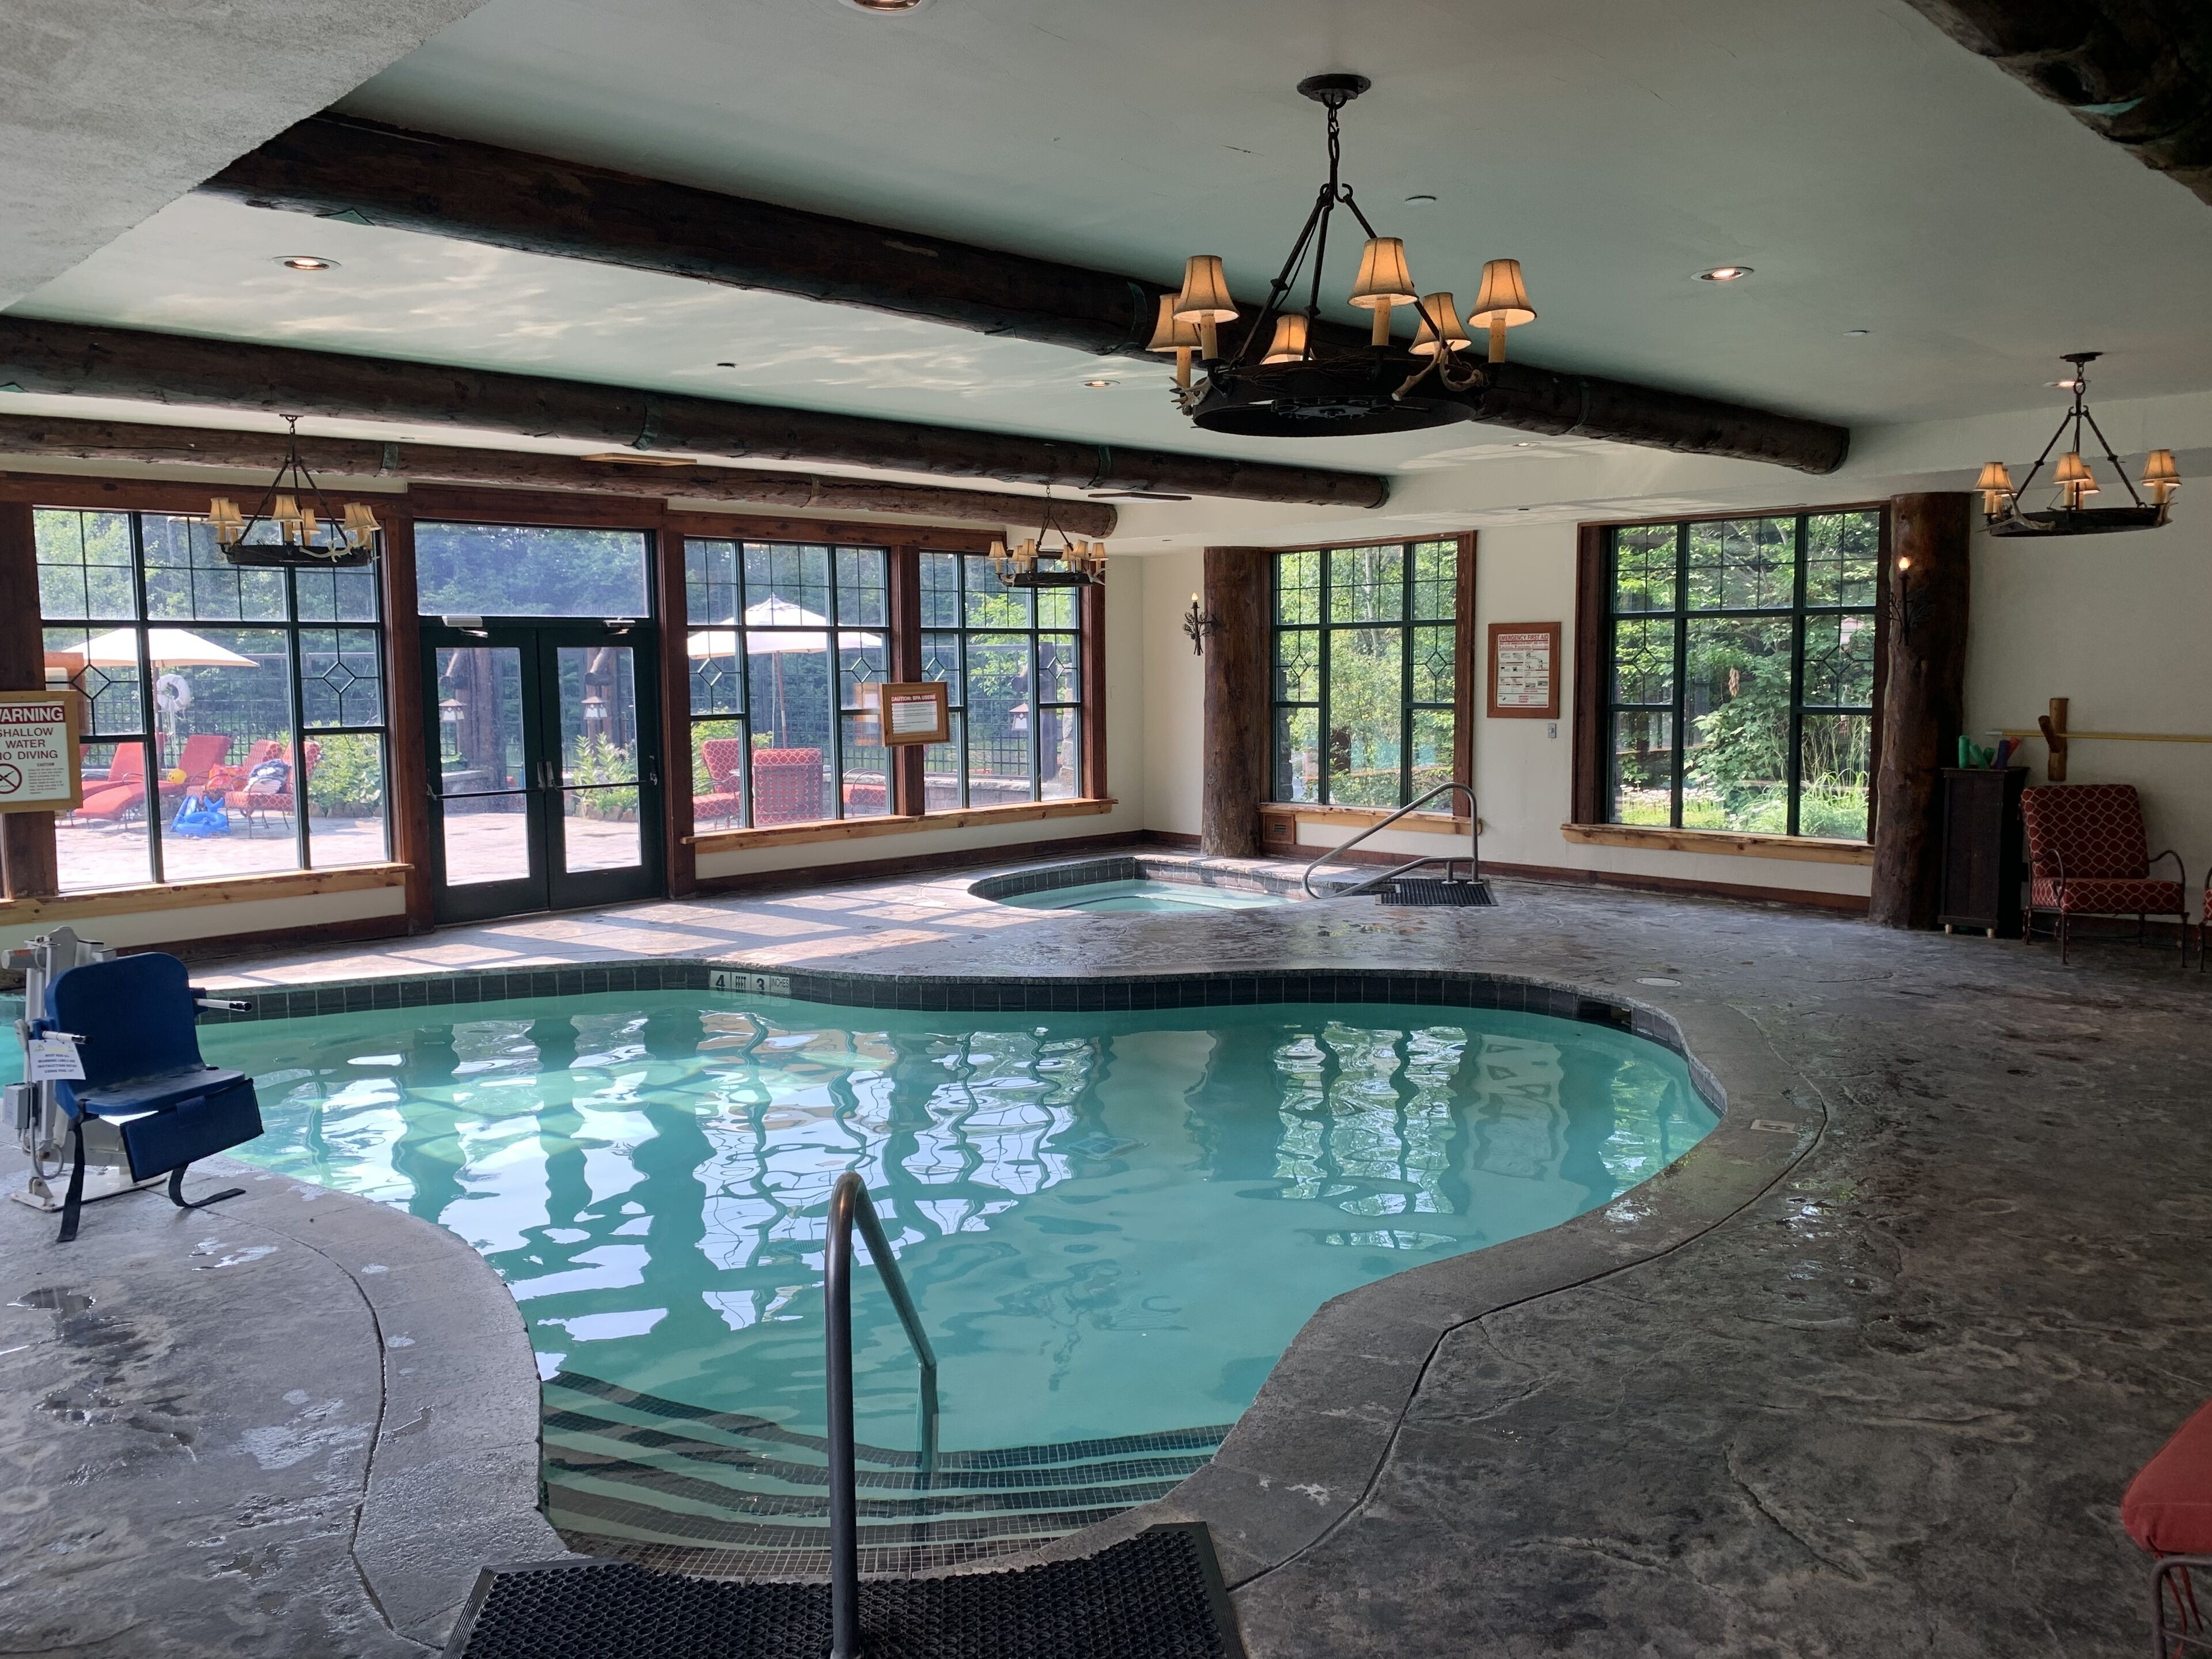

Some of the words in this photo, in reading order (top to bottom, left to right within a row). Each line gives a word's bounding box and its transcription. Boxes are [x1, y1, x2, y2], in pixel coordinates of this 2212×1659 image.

[0, 707, 63, 722] ARNING
[5, 739, 46, 748] WATER
[0, 752, 12, 760] O
[18, 750, 58, 759] DIVING
[715, 975, 725, 987] 4
[756, 978, 765, 990] 3
[771, 978, 789, 988] INCHES
